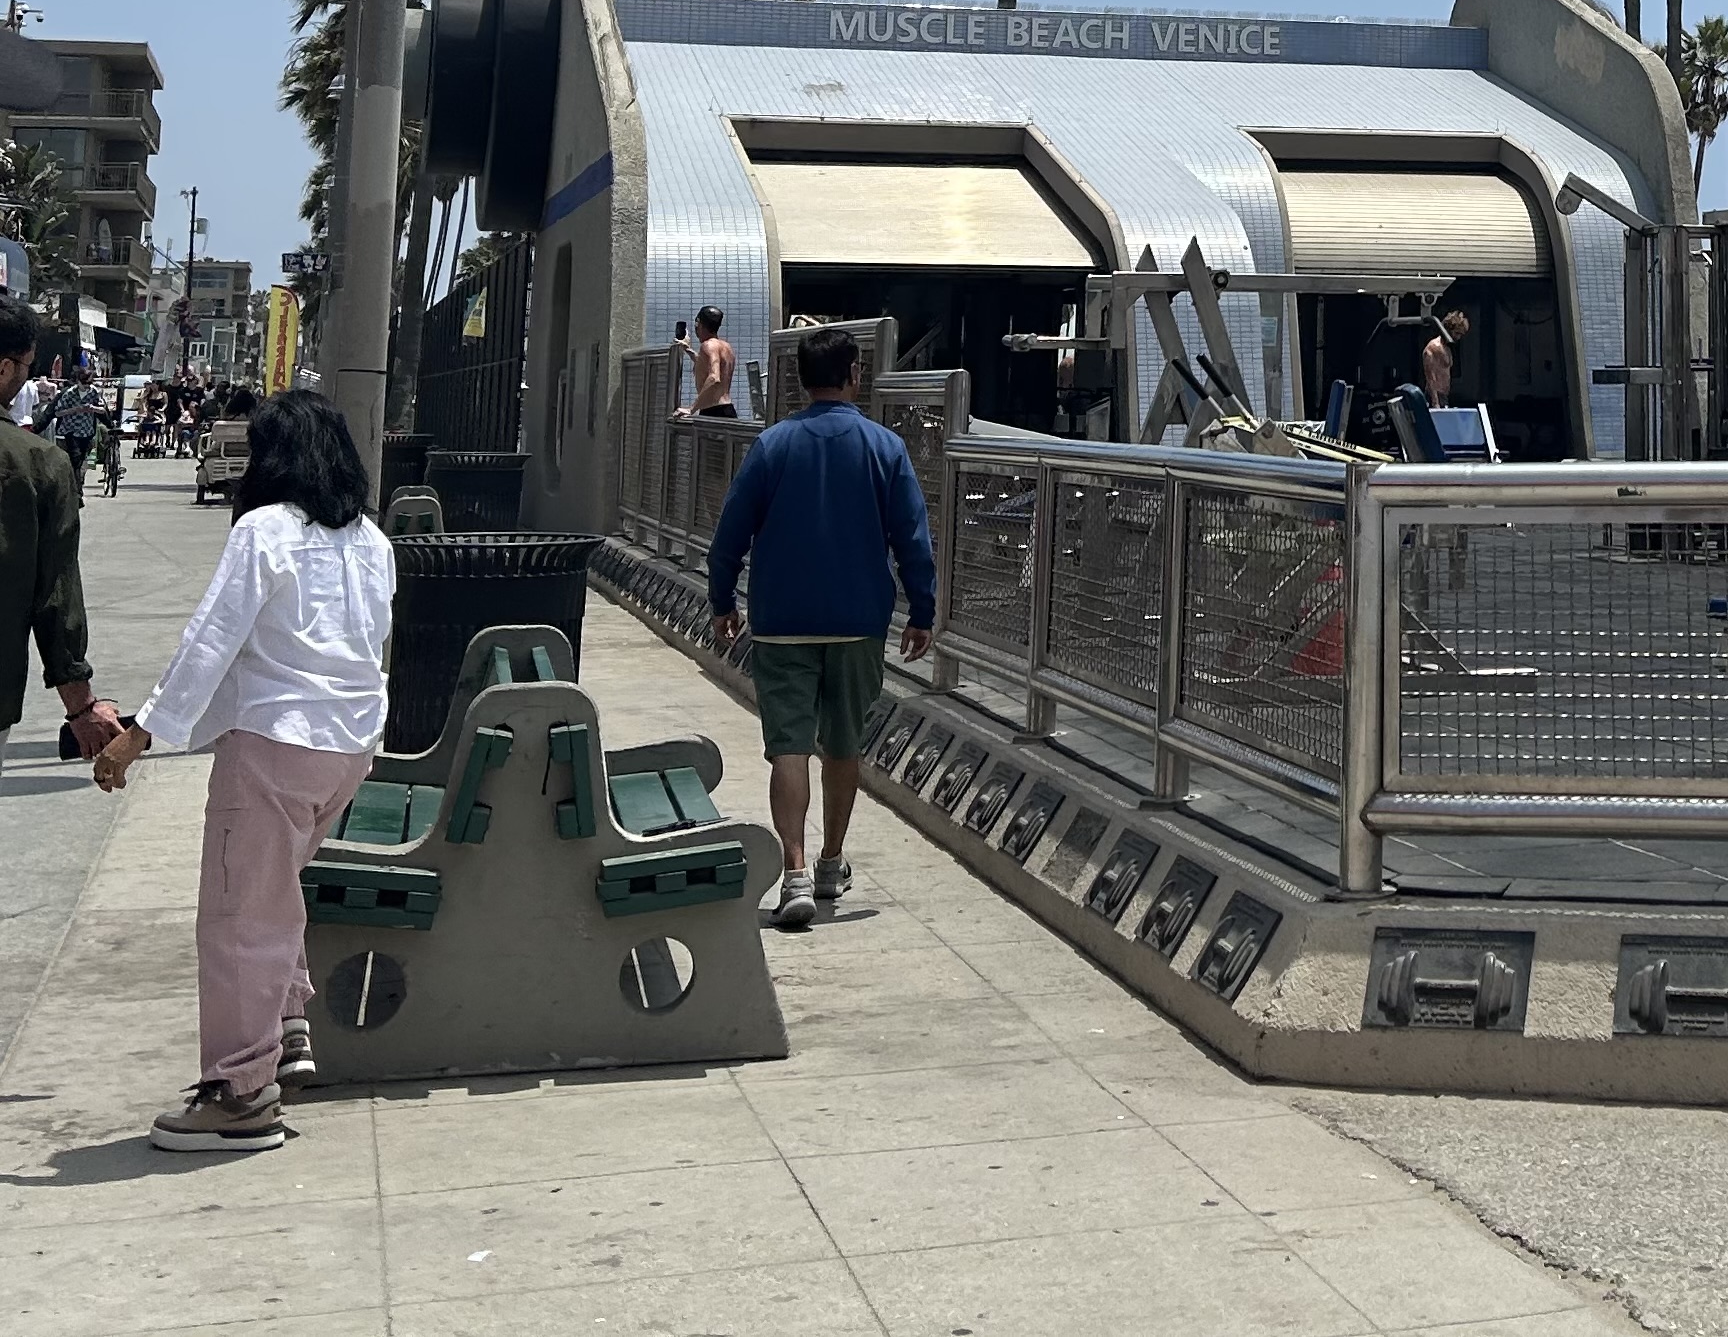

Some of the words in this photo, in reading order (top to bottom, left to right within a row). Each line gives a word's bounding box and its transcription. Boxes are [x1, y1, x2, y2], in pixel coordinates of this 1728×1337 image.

[829, 9, 985, 45] MUSCLE
[1006, 16, 1130, 49] BEACH
[1152, 22, 1280, 54] VENICE
